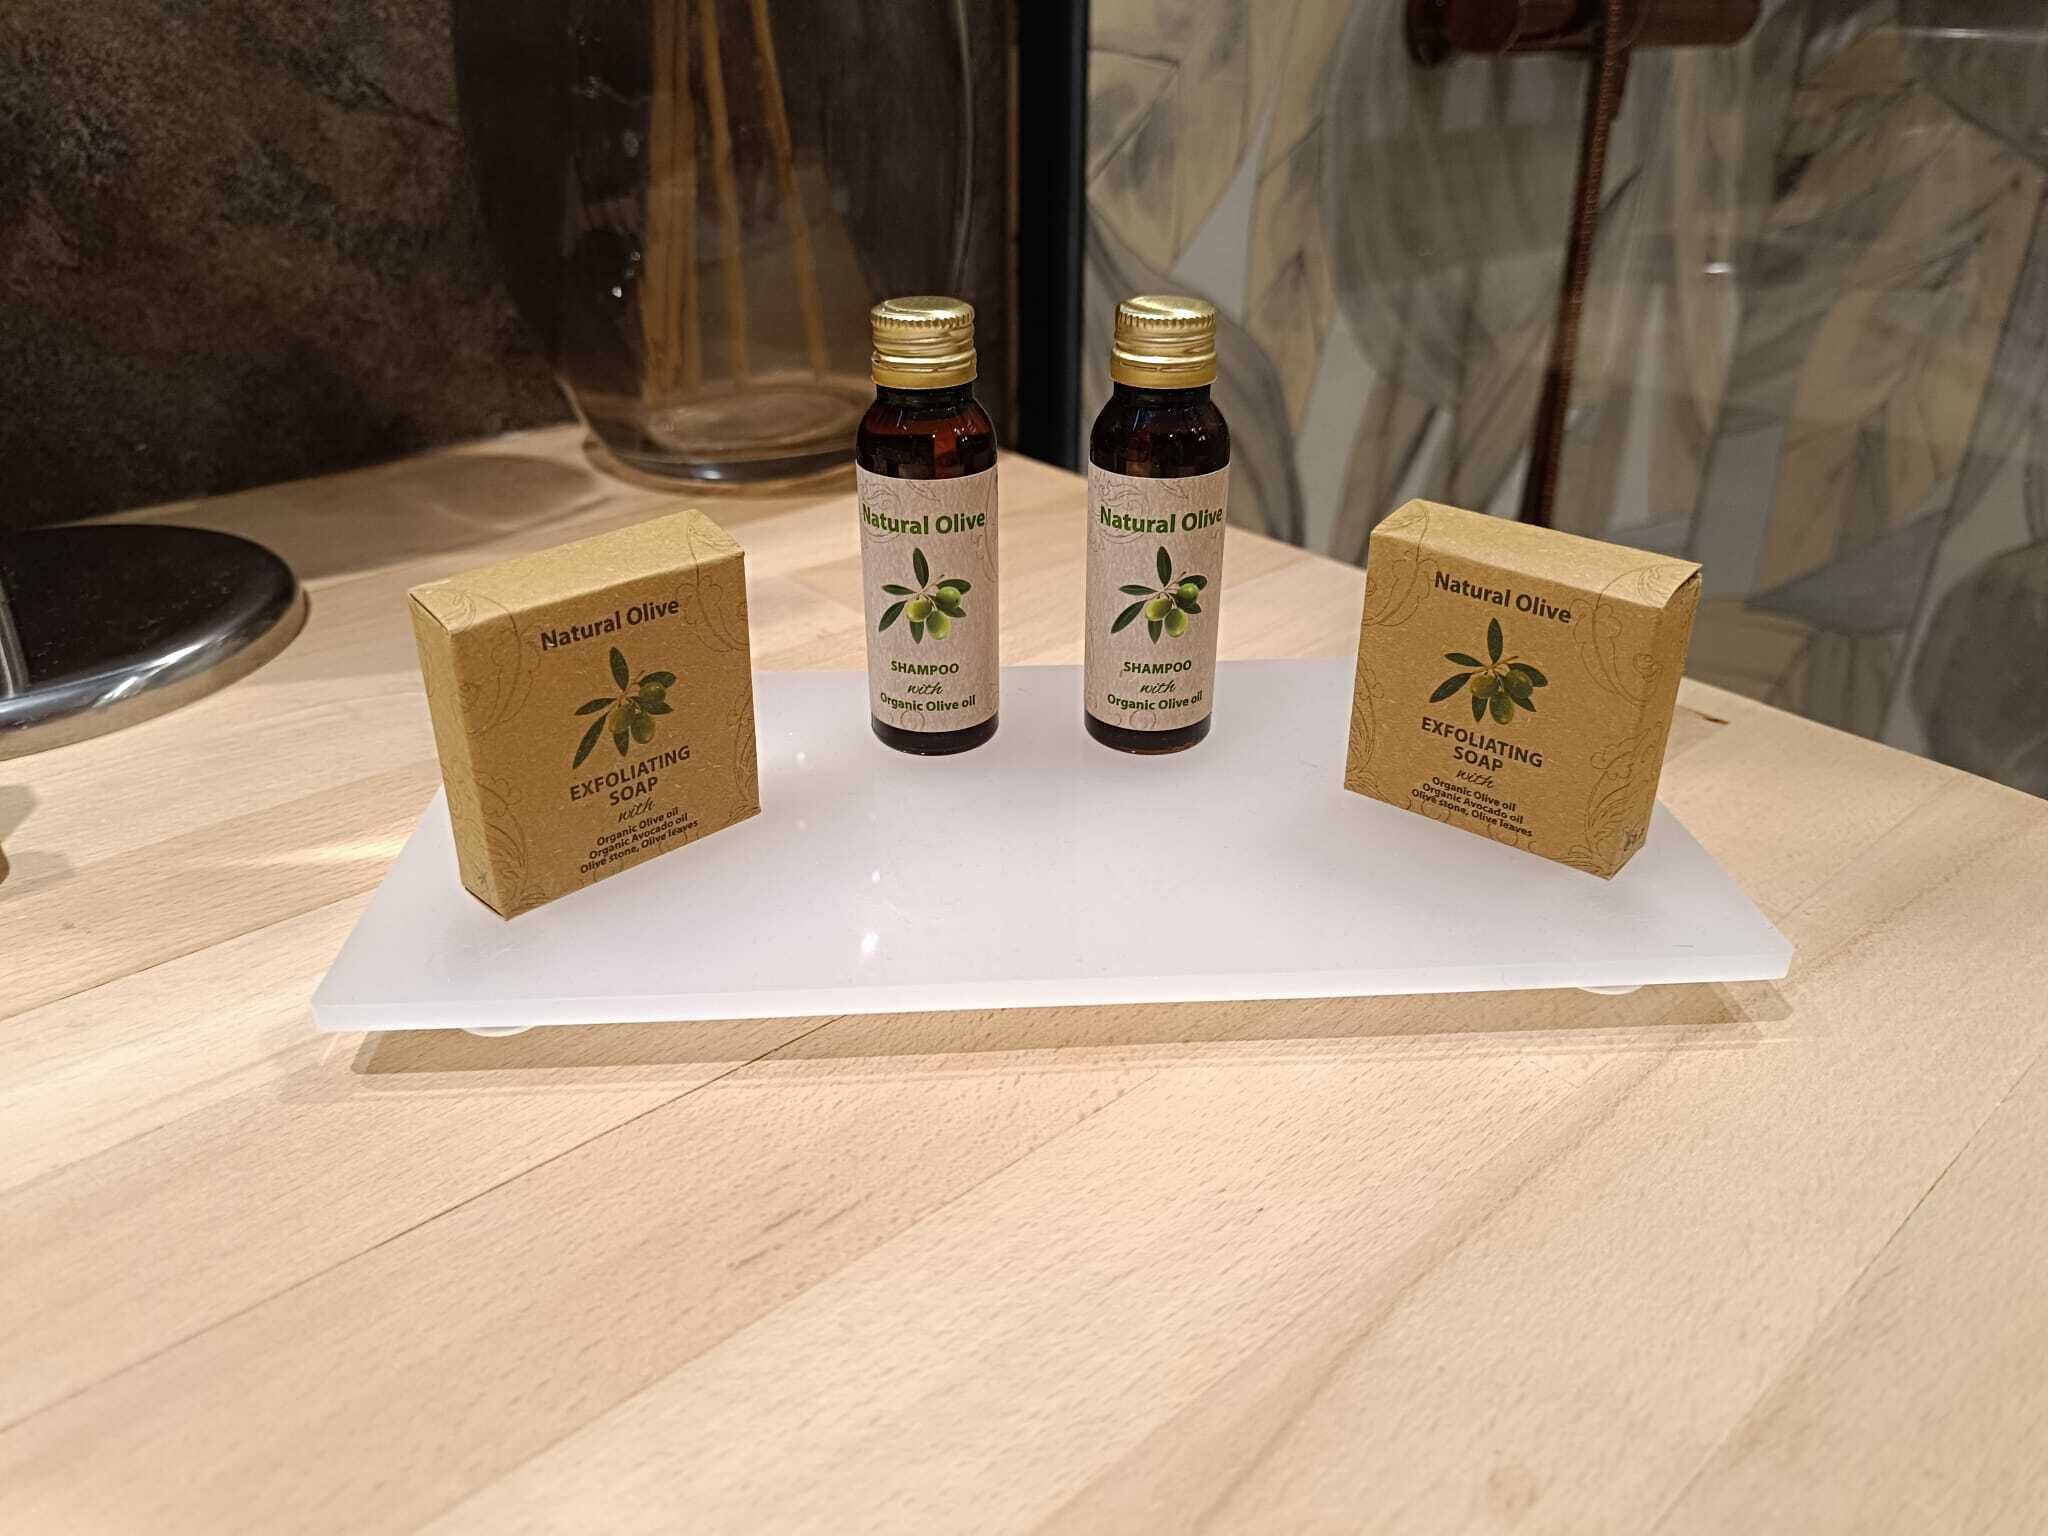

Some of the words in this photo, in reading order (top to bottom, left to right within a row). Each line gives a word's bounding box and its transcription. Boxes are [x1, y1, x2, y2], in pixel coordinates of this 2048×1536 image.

[862, 503, 929, 535] Natural
[935, 512, 985, 534] Olive
[1100, 505, 1176, 533] Natural
[1181, 508, 1223, 531] Olive
[1434, 571, 1511, 607] Natural
[1515, 594, 1572, 623] Olive
[540, 611, 621, 651] Natural
[627, 600, 679, 626] Olive
[891, 660, 959, 675] SHAMPOO
[1123, 660, 1192, 674] SHAMPOO
[880, 692, 923, 711] Organic
[925, 700, 959, 711] Olive
[961, 694, 976, 708] oil
[907, 682, 943, 695] with
[1107, 694, 1155, 710] Organic
[1158, 698, 1189, 710] Olive
[1190, 690, 1202, 704] oil
[1140, 680, 1176, 694] with
[1421, 716, 1543, 768] EXFOLIATING
[570, 745, 690, 801] EXFOLIATING
[1453, 746, 1503, 772] SOAP
[609, 776, 658, 807] SOAP
[1432, 776, 1472, 797] Organic
[1474, 791, 1500, 807] Olive
[1502, 802, 1516, 812] oil
[1456, 769, 1495, 789] with
[618, 797, 655, 823] with
[1411, 788, 1437, 804] Olive
[1438, 800, 1469, 817] stone,
[1471, 809, 1498, 826] Olive
[1500, 818, 1533, 838] leaves
[1422, 783, 1461, 804] Organic
[1463, 797, 1508, 819] Avocado
[1510, 814, 1523, 824] oil
[589, 838, 629, 859] Organic
[632, 819, 674, 843] Avocado
[675, 813, 688, 825] oil
[597, 825, 637, 846] Organic
[639, 814, 664, 830] Olive
[666, 807, 679, 819] oil
[580, 858, 607, 874] Olive
[608, 845, 640, 863] stone,
[641, 833, 666, 849] Olive
[668, 820, 699, 838] leaves
